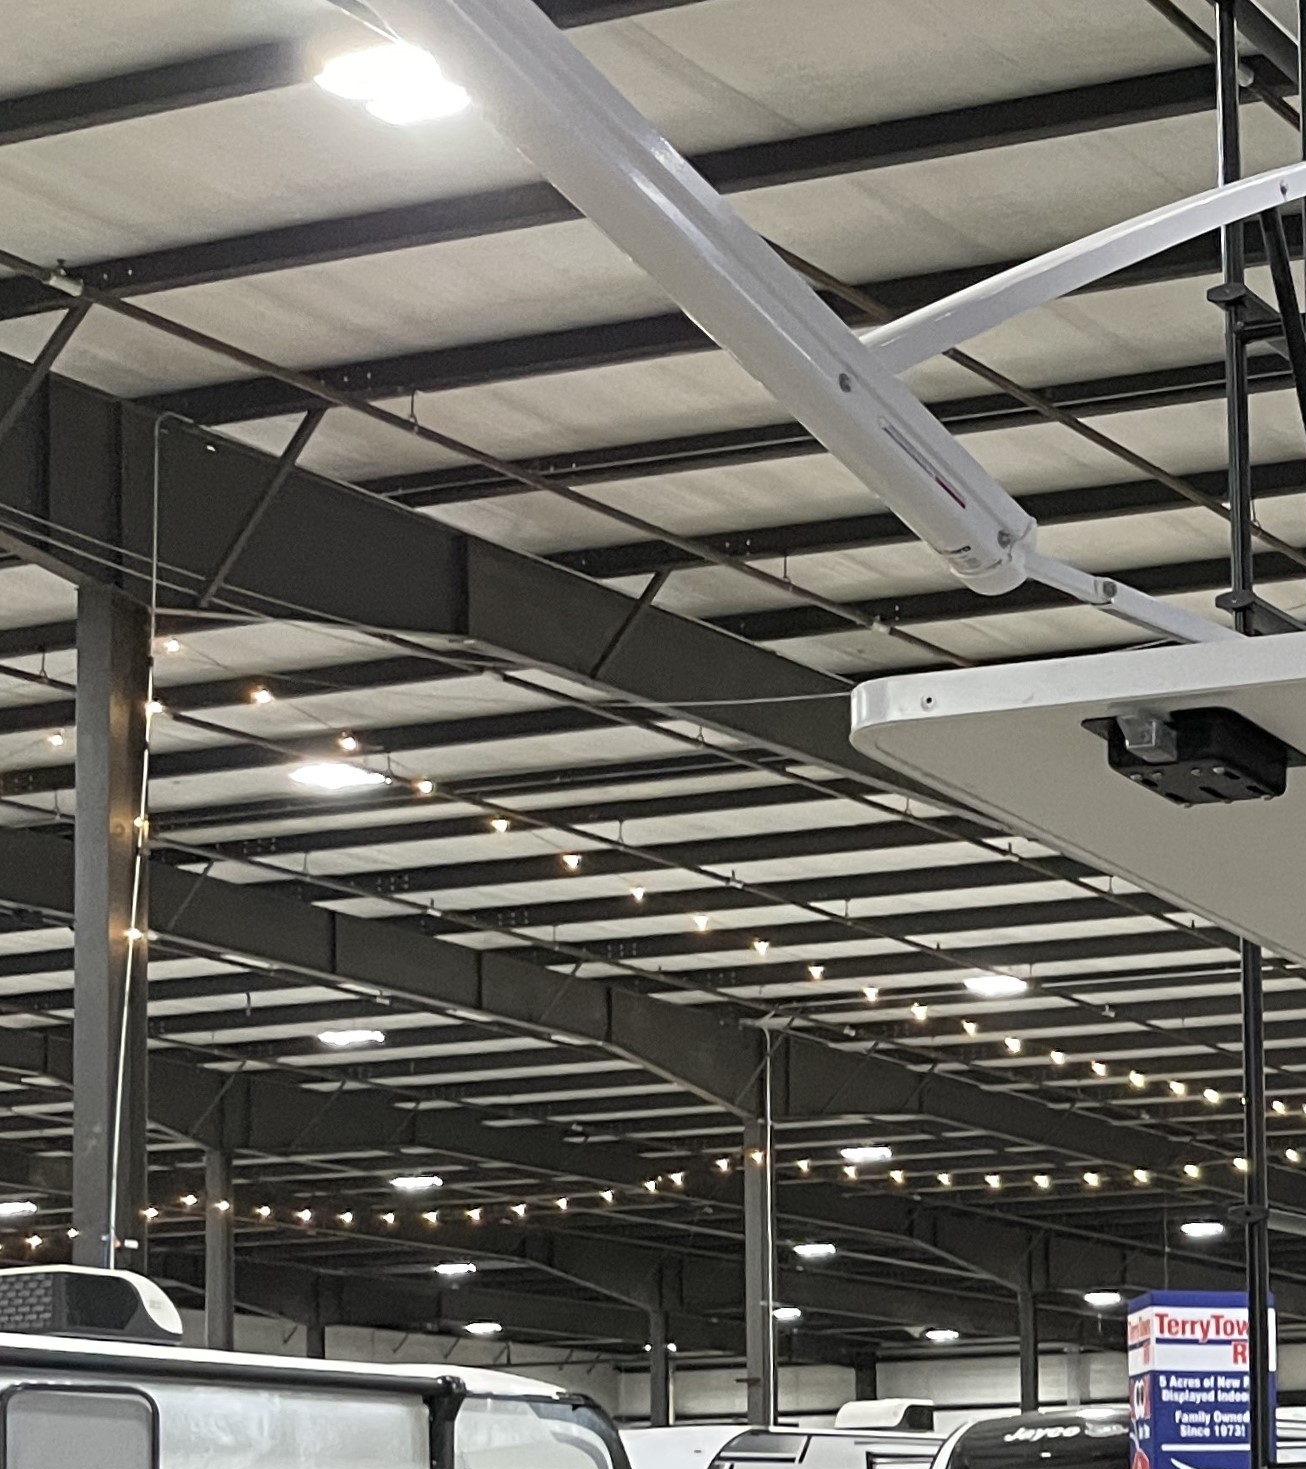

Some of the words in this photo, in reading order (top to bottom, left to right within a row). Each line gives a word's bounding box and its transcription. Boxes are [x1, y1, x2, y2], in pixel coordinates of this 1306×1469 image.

[1169, 1376, 1201, 1389] Acres
[1203, 1376, 1215, 1389] of
[1217, 1376, 1241, 1389] New
[1161, 1389, 1215, 1404] Displayed
[1175, 1410, 1211, 1425] Family
[1004, 1426, 1081, 1441] Jayco
[1180, 1425, 1210, 1437] Since
[1214, 1425, 1246, 1437] 1973!
